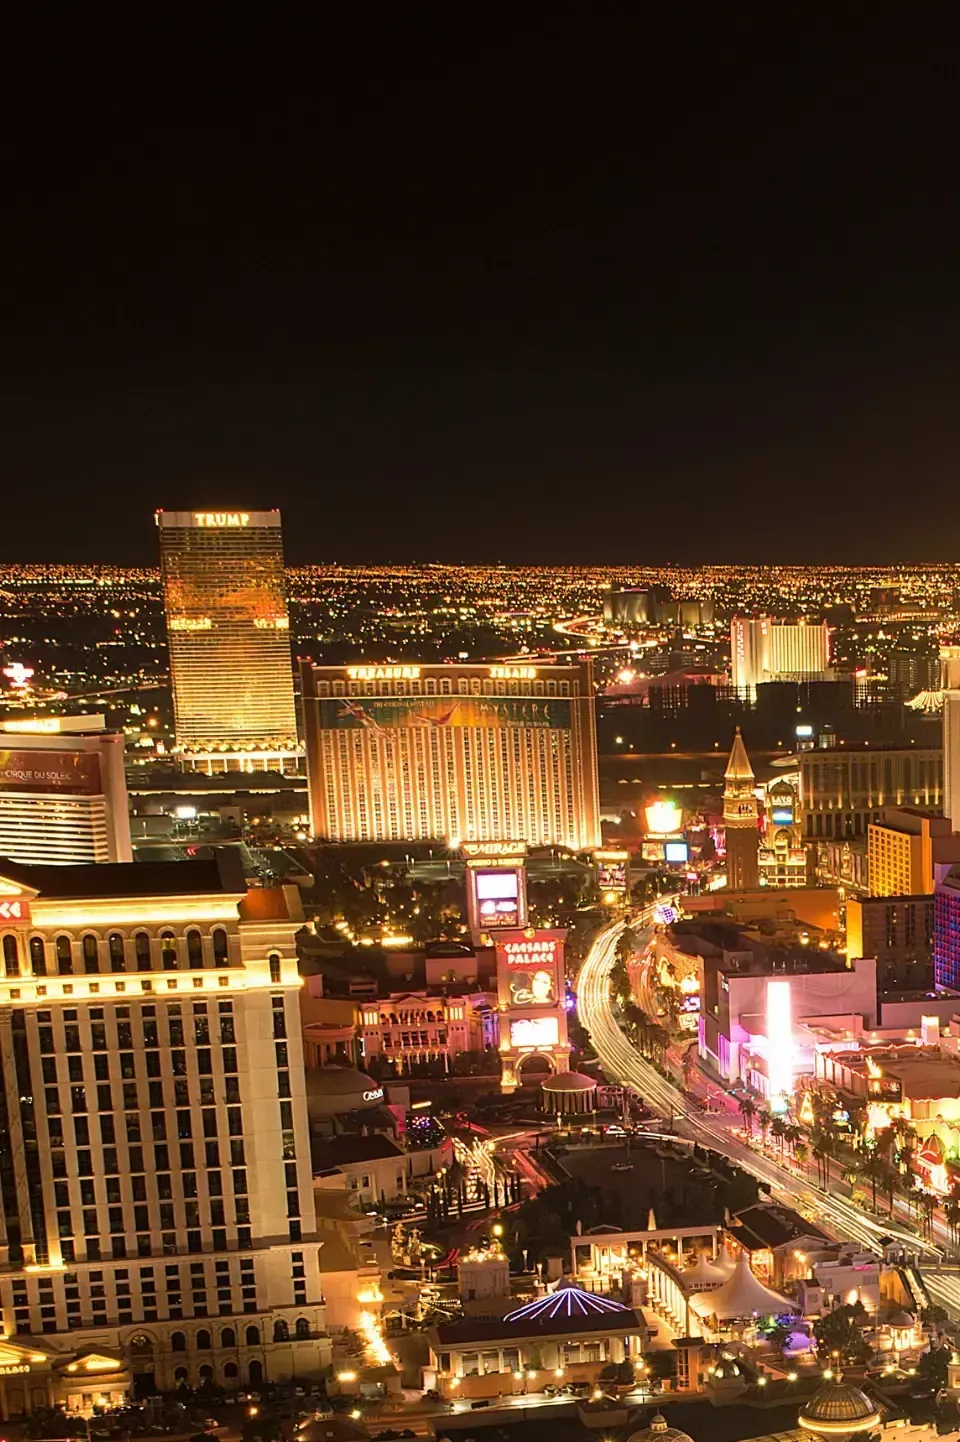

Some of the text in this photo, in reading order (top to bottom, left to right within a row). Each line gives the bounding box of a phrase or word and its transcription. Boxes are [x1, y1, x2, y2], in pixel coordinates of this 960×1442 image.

[195, 513, 249, 527] TRUMP
[347, 667, 537, 680] TREASURE ISLAND
[5, 769, 72, 781] CIRQUE DU SOLEIL
[480, 842, 526, 855] MIRAGE
[504, 941, 556, 953] CAESARS
[507, 953, 554, 964] PALACE
